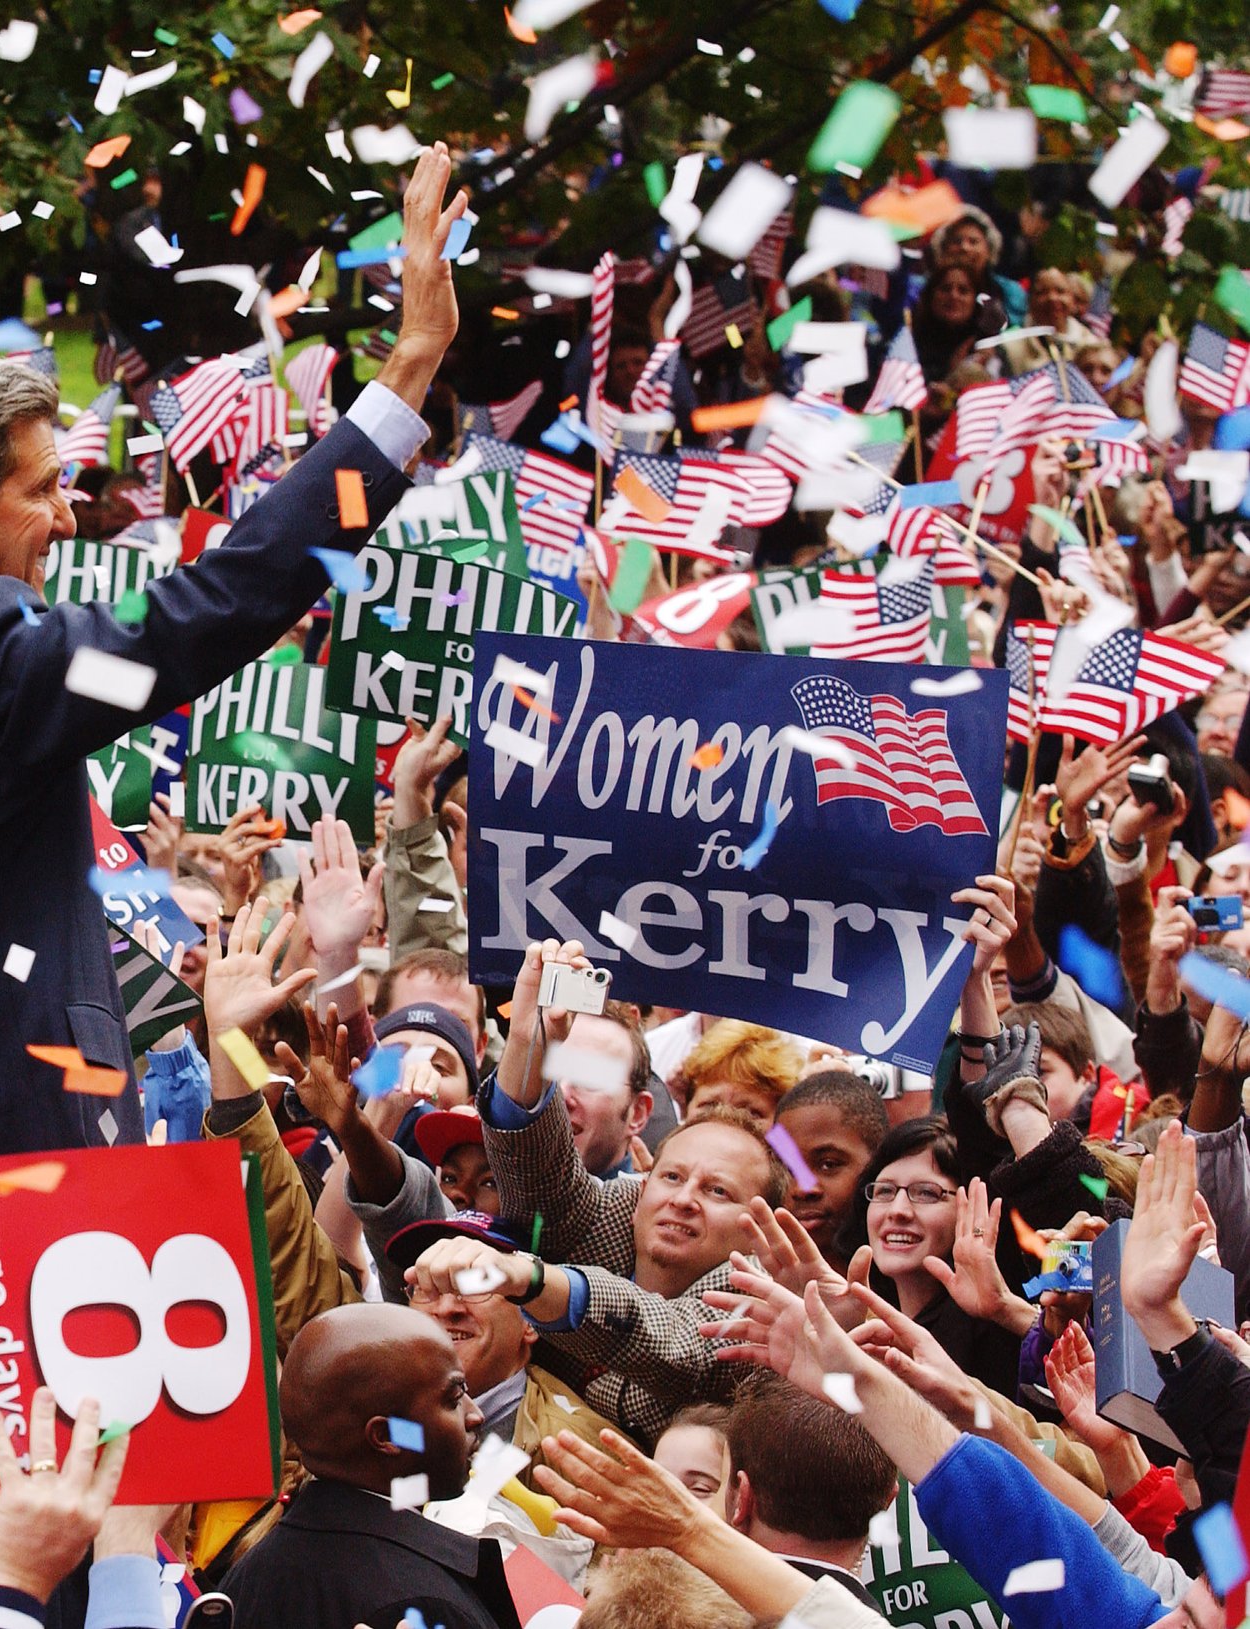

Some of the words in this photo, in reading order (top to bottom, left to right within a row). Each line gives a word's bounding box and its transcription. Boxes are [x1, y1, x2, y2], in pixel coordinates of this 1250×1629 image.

[444, 639, 476, 664] FO
[352, 651, 474, 736] KER
[476, 644, 794, 825] Women
[197, 763, 350, 833] KERRY
[100, 842, 129, 870] to
[681, 828, 767, 878] fo
[479, 825, 970, 1056] Kerry
[28, 1230, 252, 1430] 8
[882, 1579, 929, 1616] FOR
